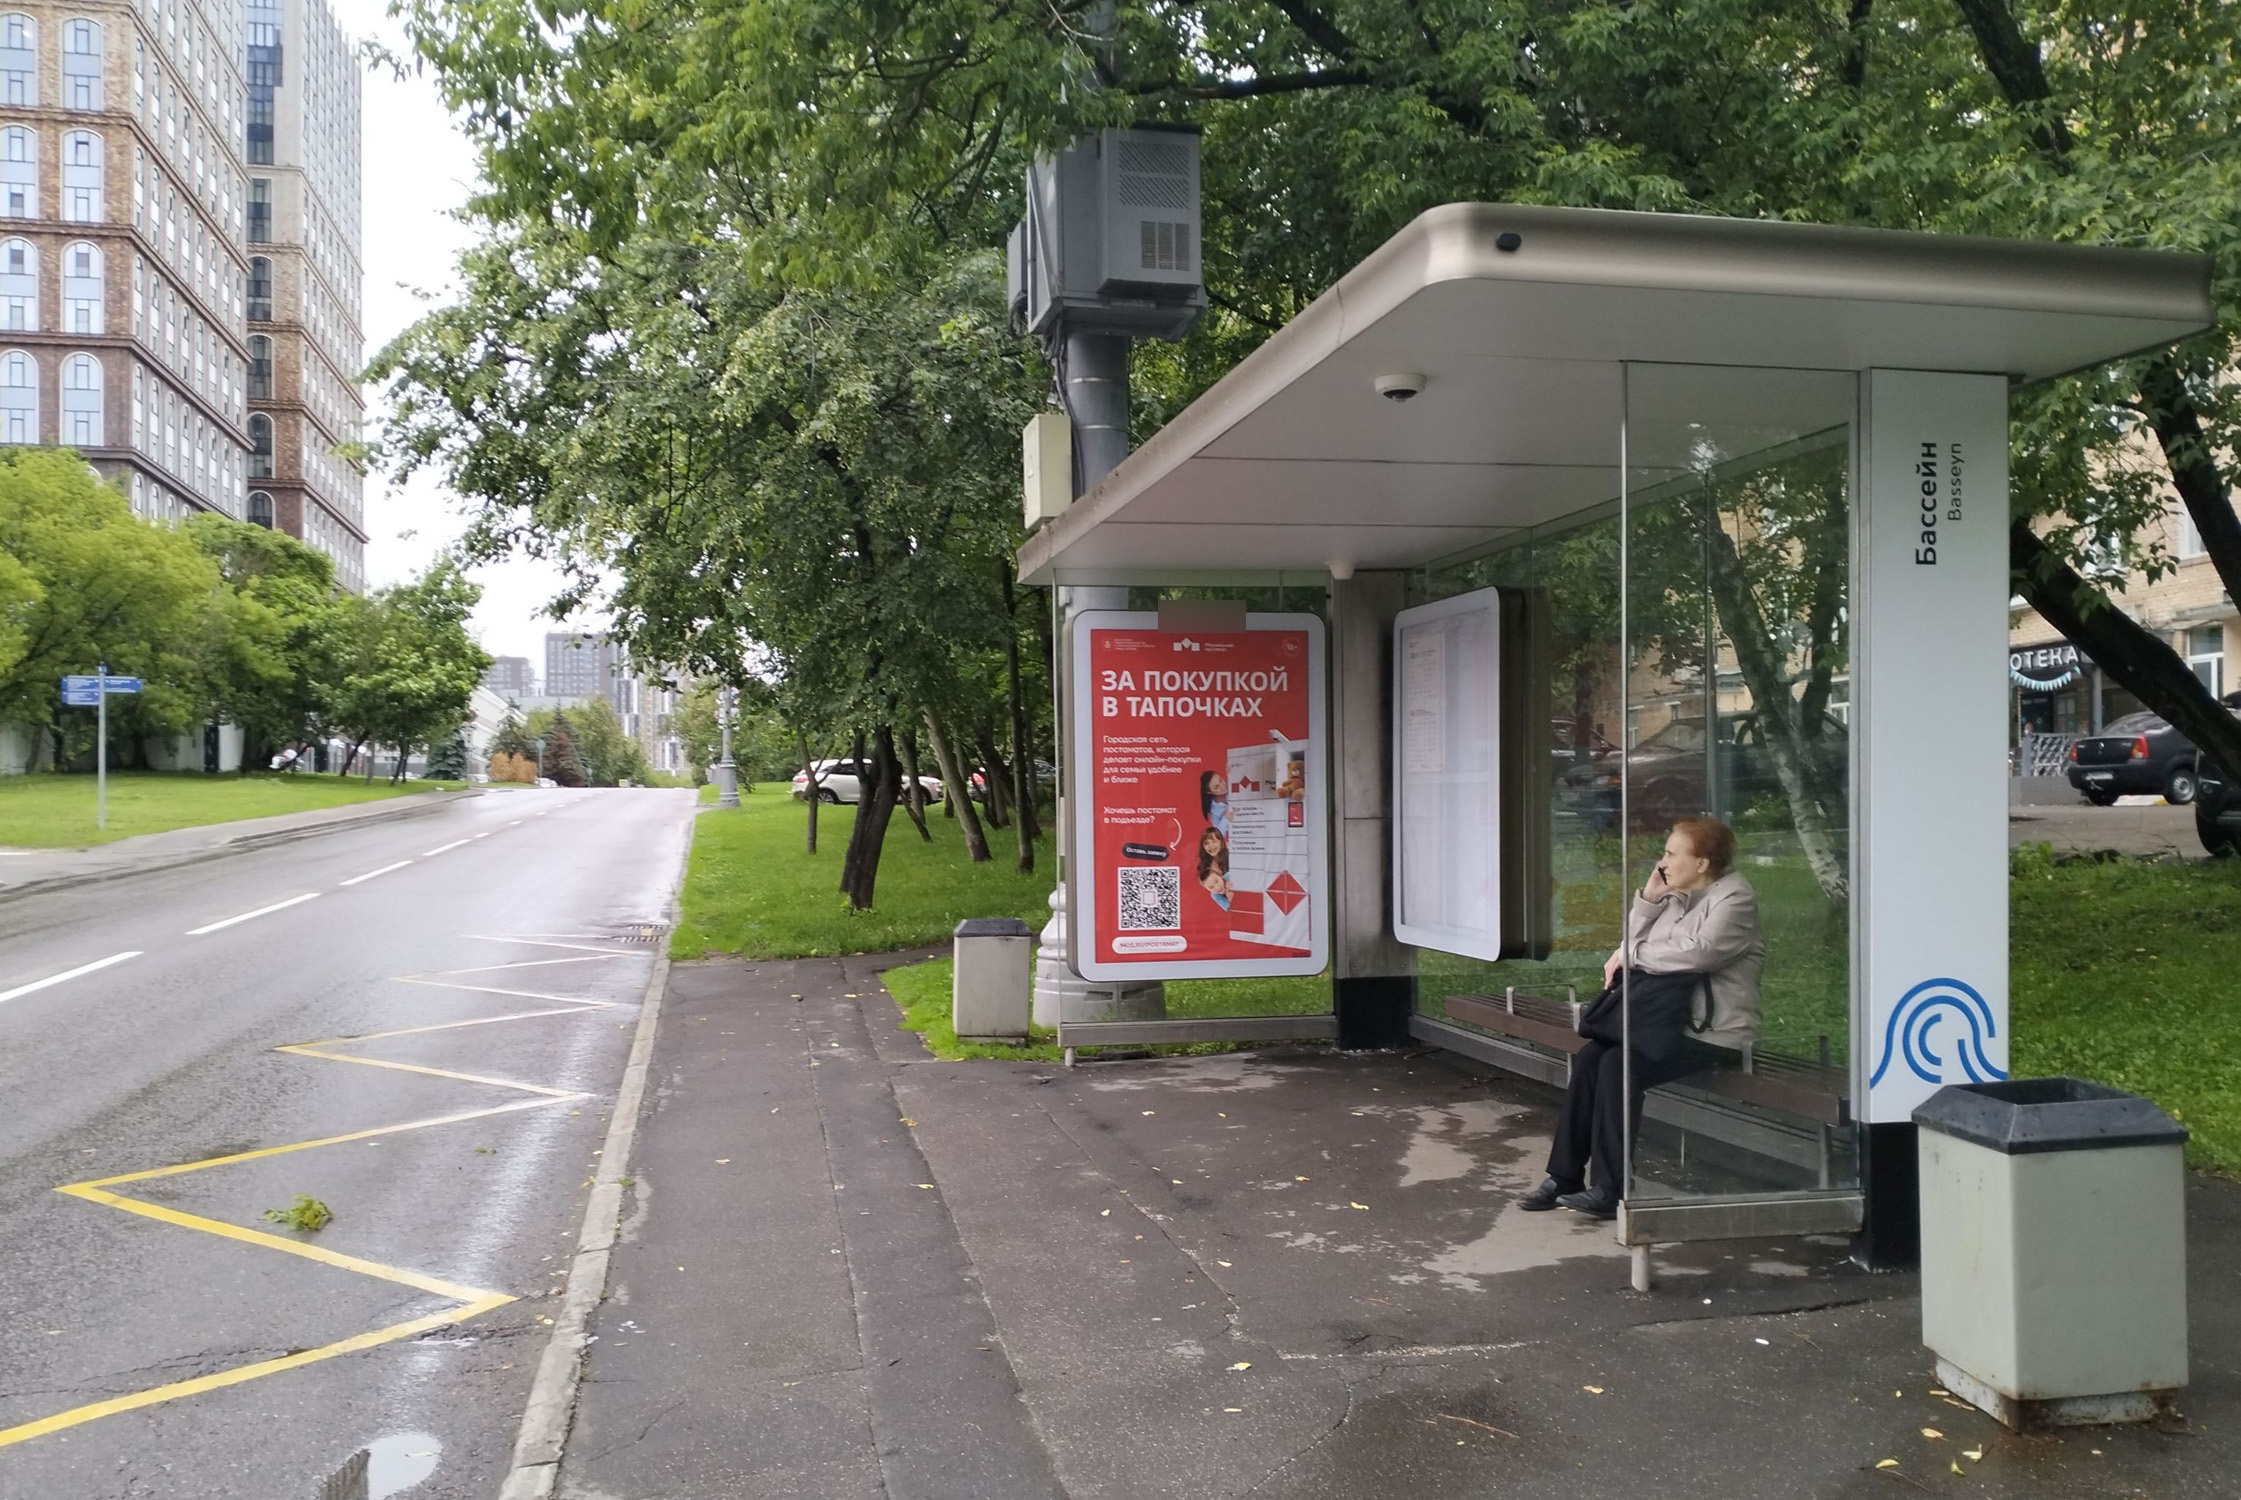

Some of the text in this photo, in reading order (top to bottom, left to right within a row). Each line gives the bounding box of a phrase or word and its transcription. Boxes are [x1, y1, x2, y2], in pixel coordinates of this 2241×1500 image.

[1948, 443, 1965, 521] Basseyn
[1915, 442, 1937, 565] Бассейн
[1101, 665, 1288, 692] ЗА ПОКУПКОЙ
[1102, 696, 1263, 717] В ТАПОЧКАХ
[1103, 735, 1148, 744] Городская
[1148, 765, 1182, 774] удобнее
[1104, 806, 1136, 814] Хочешь
[1111, 815, 1155, 824] подъезде?
